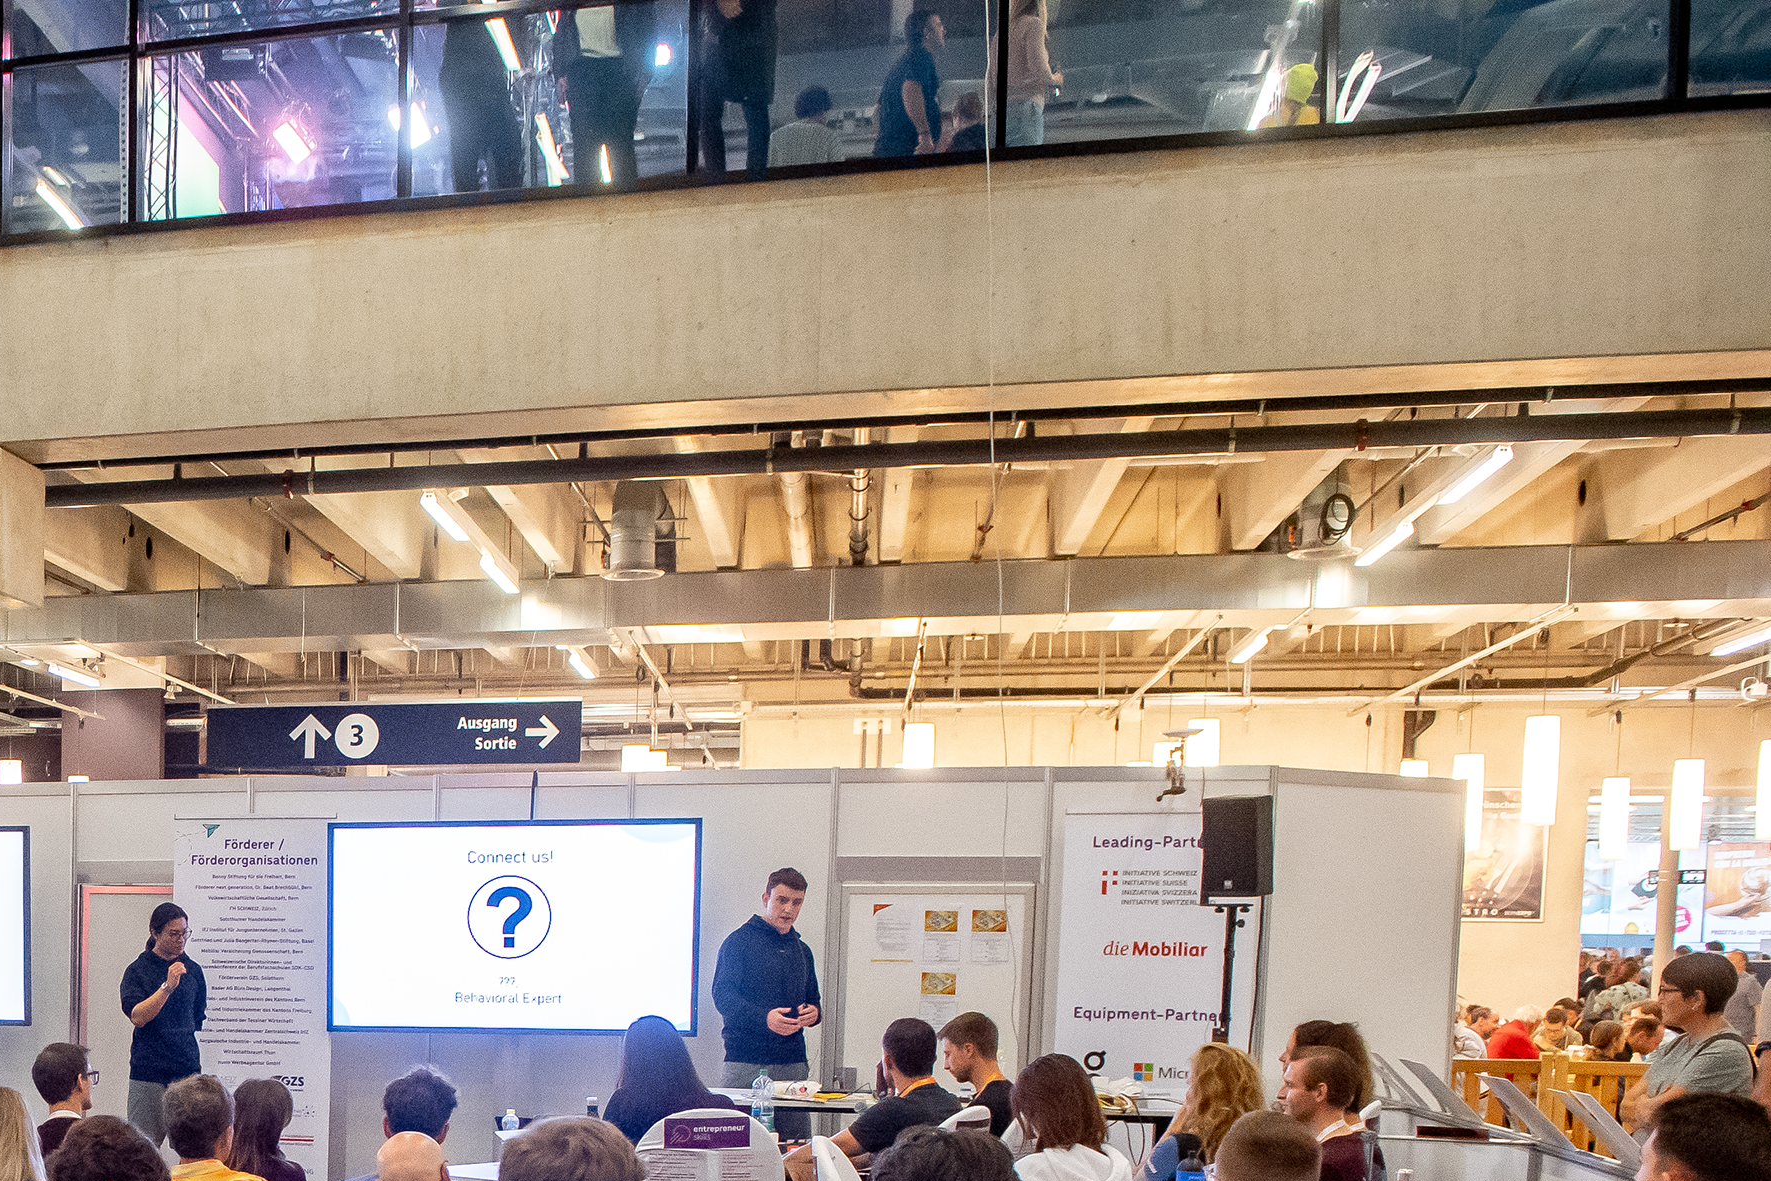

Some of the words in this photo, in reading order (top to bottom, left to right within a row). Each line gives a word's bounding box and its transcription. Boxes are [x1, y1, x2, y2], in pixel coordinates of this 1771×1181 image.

[456, 716, 518, 732] Ausgang
[349, 724, 365, 746] 3
[474, 737, 517, 750] Sortie
[224, 839, 275, 849] Förderer
[1093, 835, 1204, 850] Leading-Part
[191, 855, 318, 868] Förderorganisationen
[467, 850, 526, 864] Connect
[531, 850, 554, 864] us!
[1103, 940, 1129, 956] die
[1132, 941, 1208, 957] Mobiliar
[454, 991, 519, 1004] Behavioral
[523, 992, 562, 1005] Expert
[1074, 1006, 1223, 1022] Equipment-Partne
[693, 1124, 745, 1133] entrepreneur
